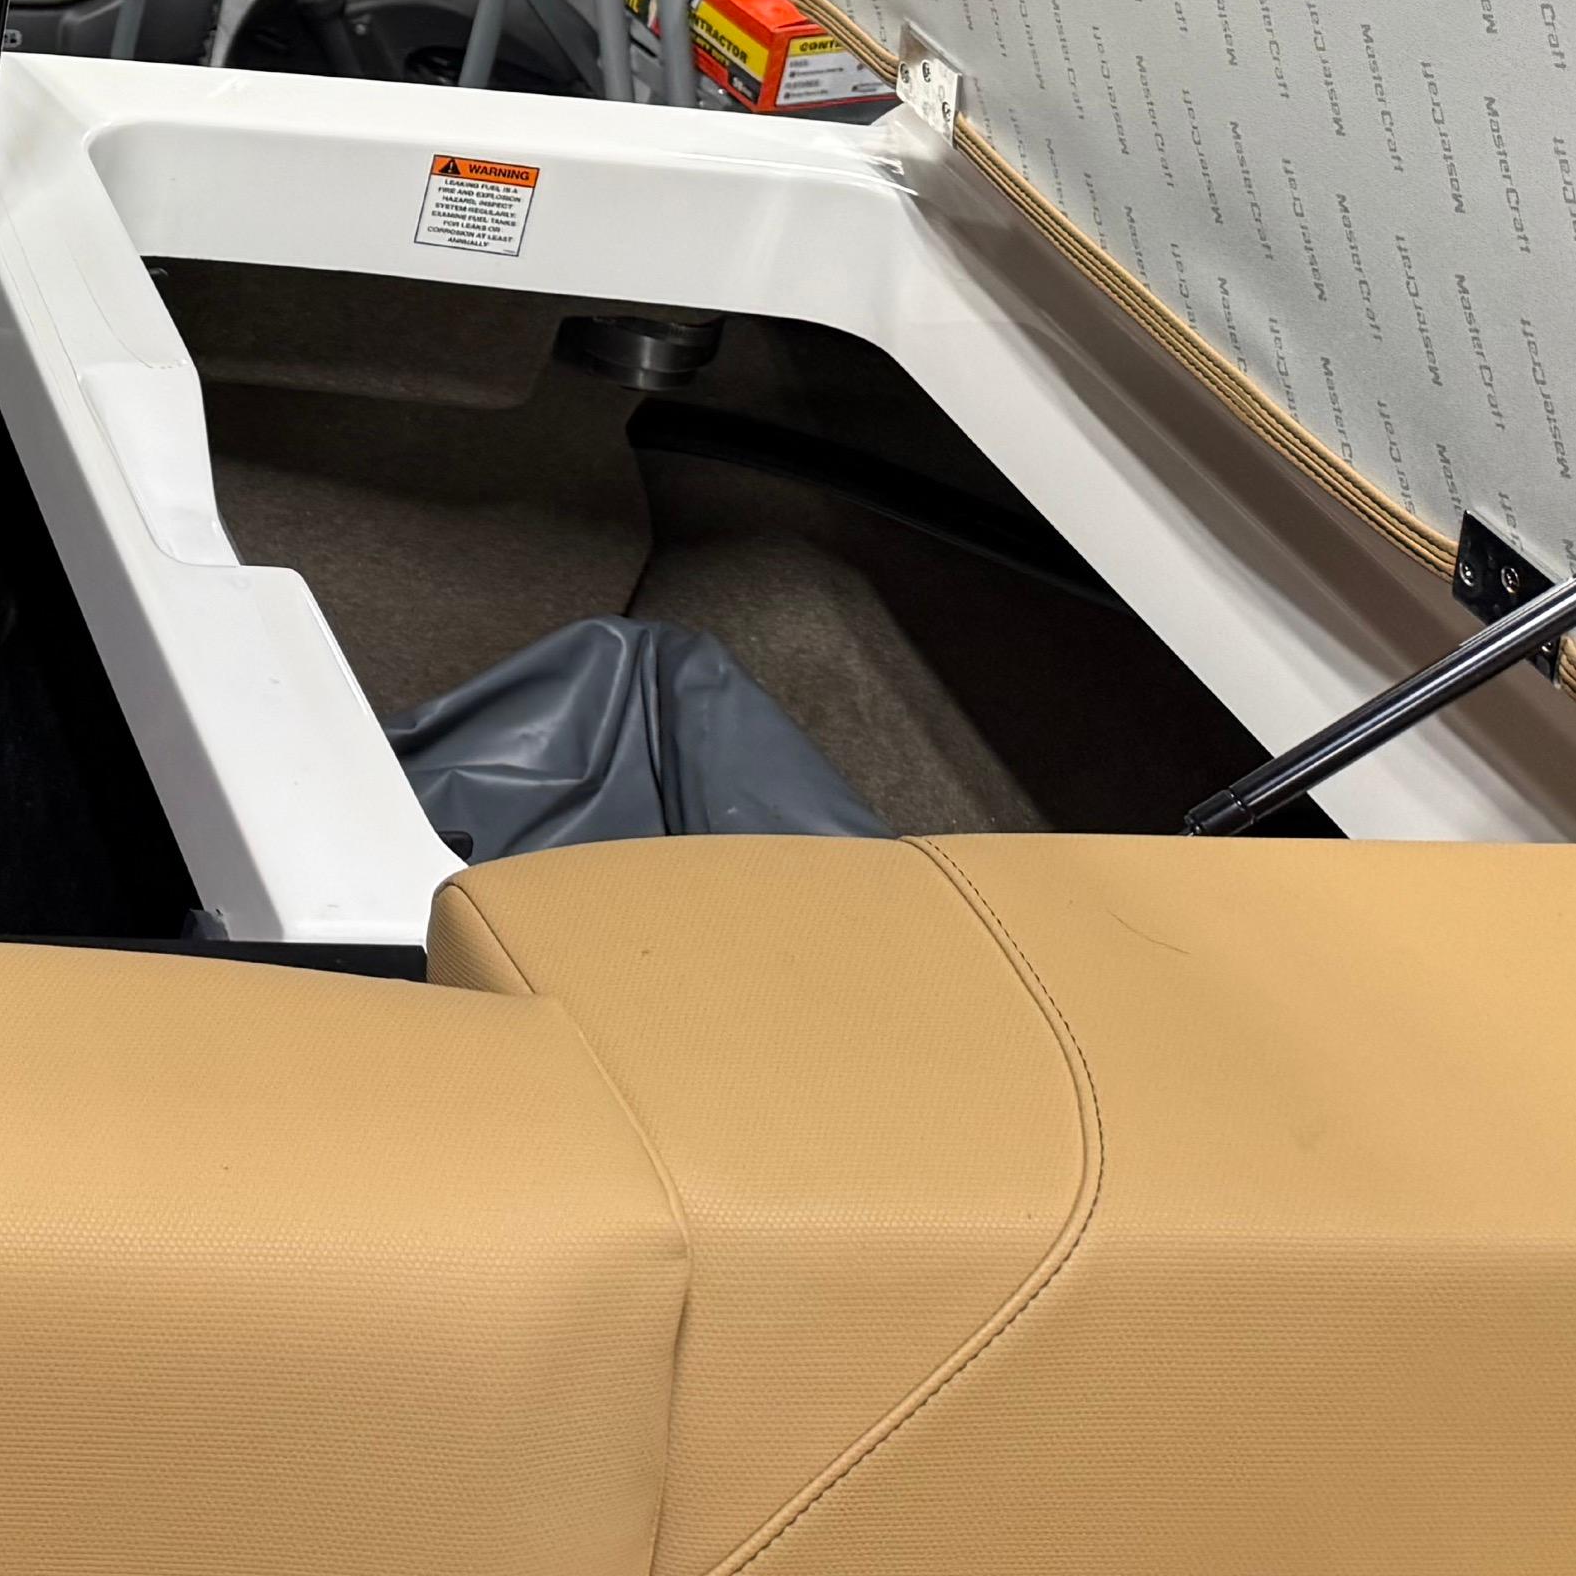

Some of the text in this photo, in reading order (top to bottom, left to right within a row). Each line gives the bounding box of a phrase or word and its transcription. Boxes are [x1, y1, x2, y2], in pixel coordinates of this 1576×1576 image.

[1359, 22, 1406, 174] MasterCraft
[468, 164, 529, 180] WARNING
[444, 179, 478, 188] LEAKING
[476, 192, 520, 201] EXPLOSION
[478, 200, 512, 209] INSPECT
[431, 211, 466, 219] EXAMINE
[427, 226, 474, 236] CORROSION
[1453, 272, 1507, 432] MasterCraft
